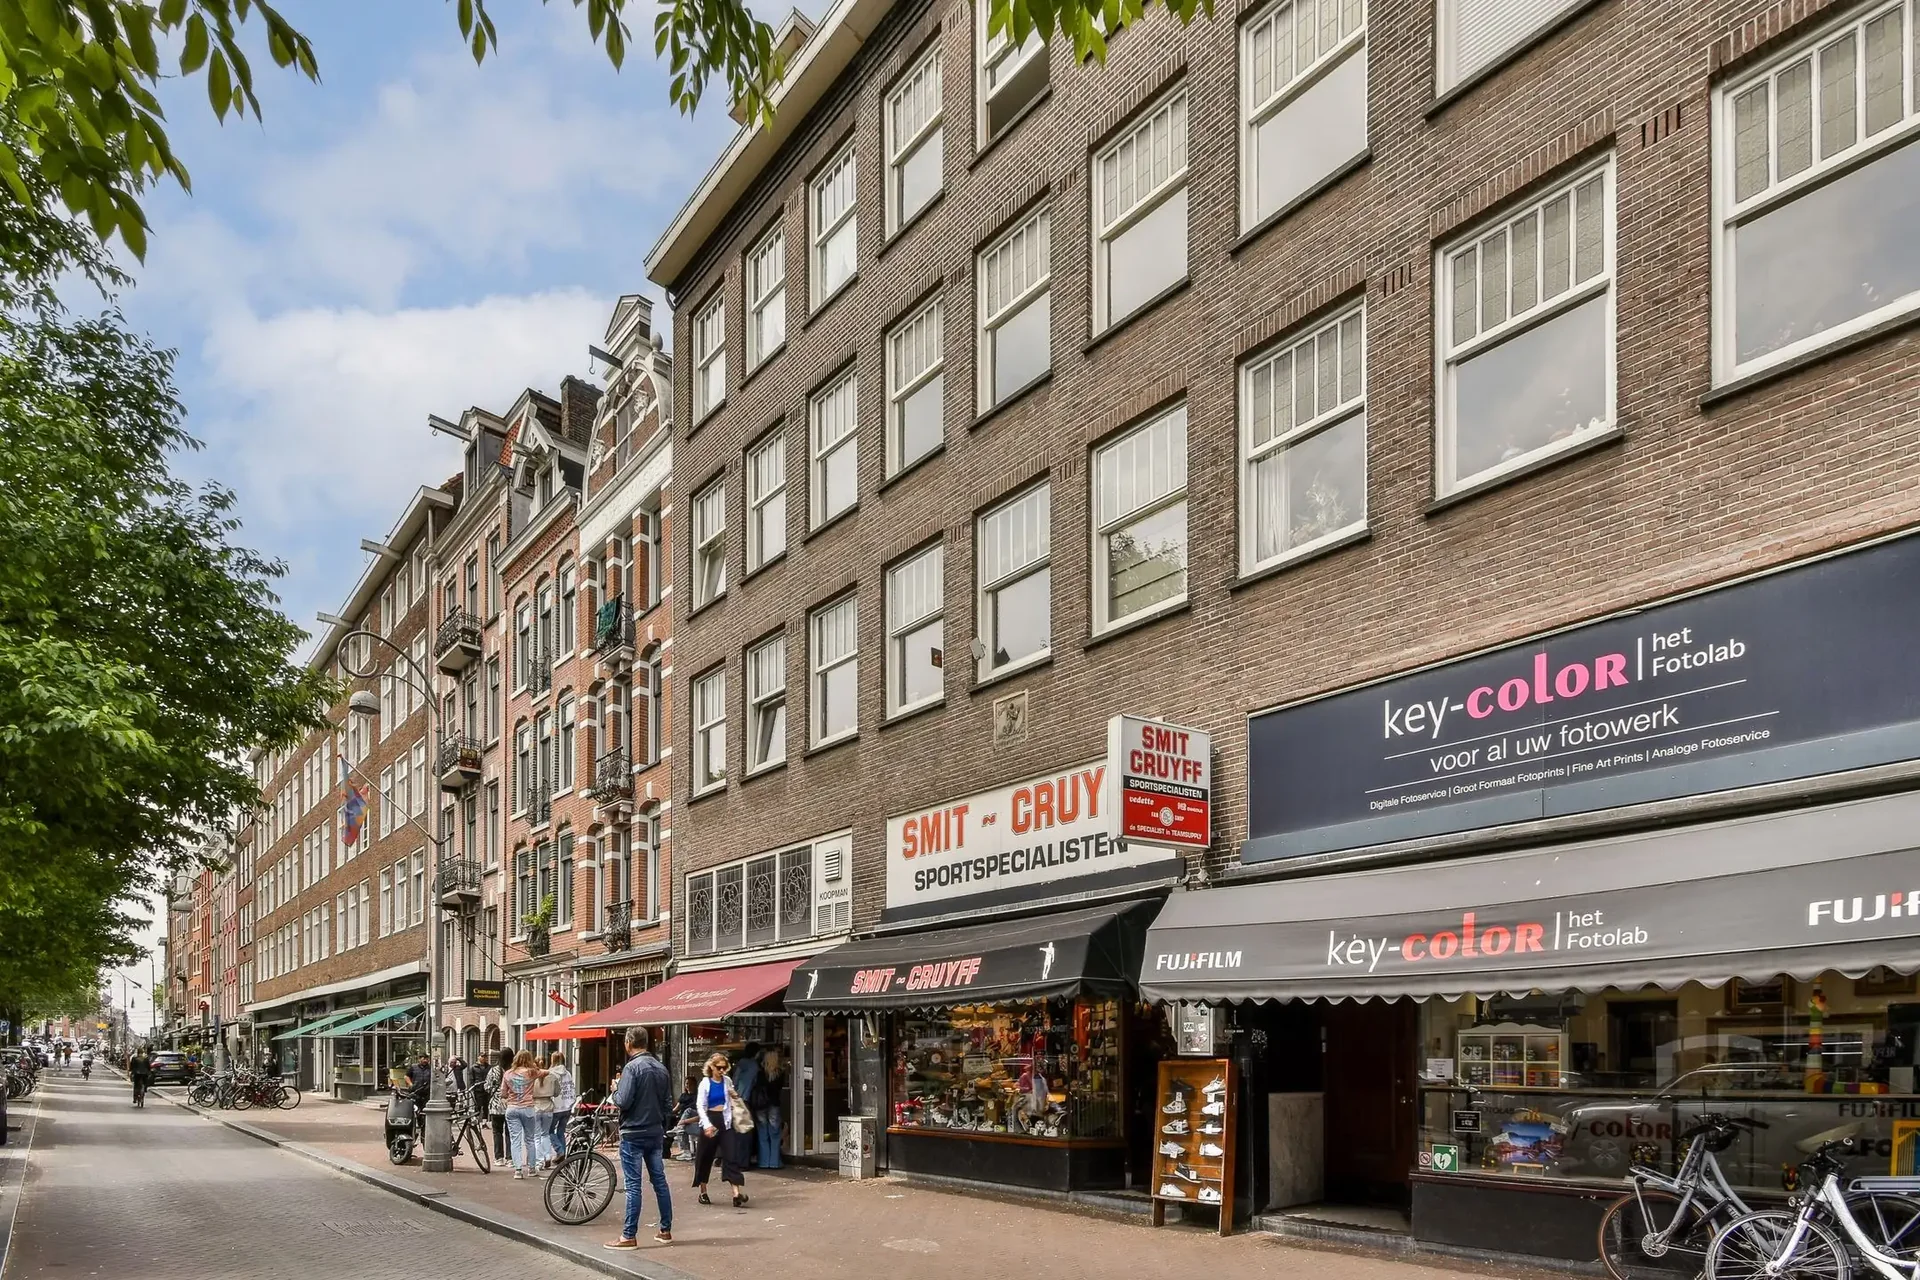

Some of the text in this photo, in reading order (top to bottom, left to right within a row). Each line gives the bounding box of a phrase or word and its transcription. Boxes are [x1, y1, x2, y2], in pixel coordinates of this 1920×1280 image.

[1652, 627, 1693, 651] het
[1652, 638, 1746, 677] Fotolab
[1141, 725, 1190, 756] SMIT
[1430, 703, 1680, 773] voor al uw fotowerk
[1130, 749, 1203, 784] CRUYFF
[1370, 729, 1771, 810] Digitale Fotoservice Groot Formaat Fotoprints Fine Art Prints Analoge Fotoservice
[1129, 779, 1203, 799] SPORTSPECIALISTEN
[902, 803, 970, 861] SMIT
[1010, 764, 1107, 836] CRUY
[1136, 825, 1165, 835] SPECIALIST
[1171, 829, 1203, 840] TEAMSUPPLY
[914, 832, 1129, 891] SPORTSPECIALISTEN
[819, 887, 849, 901] KOOPMAN
[1568, 910, 1604, 928] het
[1567, 926, 1649, 950] Fotolab
[850, 968, 896, 994] SMIT
[906, 957, 982, 991] CRUYFF
[1156, 950, 1243, 971] FUJIFILM
